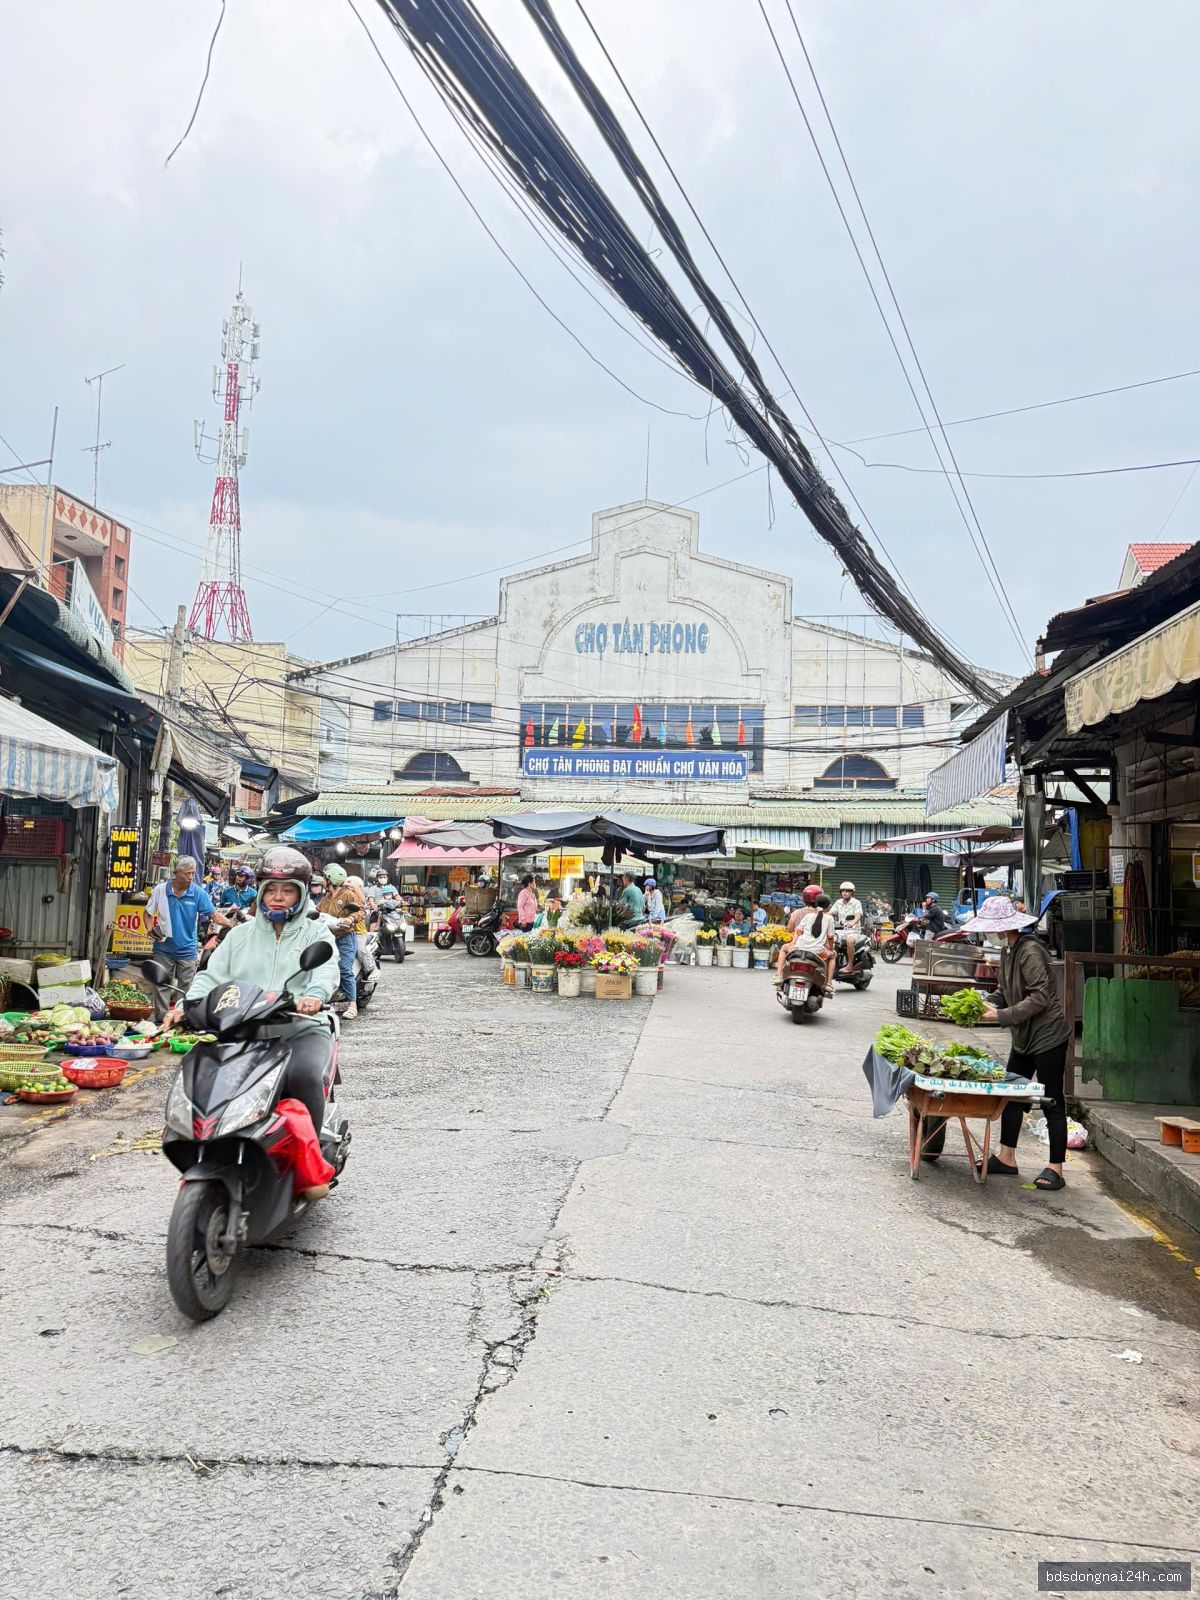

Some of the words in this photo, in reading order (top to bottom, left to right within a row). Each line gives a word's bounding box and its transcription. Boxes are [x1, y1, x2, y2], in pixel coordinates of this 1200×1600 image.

[649, 622, 709, 654] PHONG
[528, 757, 550, 775] CHỢ
[553, 756, 573, 772] TÂN
[576, 758, 610, 773] PHONG
[613, 759, 633, 776] ĐẠT
[635, 755, 671, 774] CHUẨN
[673, 759, 695, 777] CHỢ
[698, 758, 720, 775] VĂN
[722, 758, 743, 776] HÓA
[118, 844, 131, 857] MÌ
[113, 860, 132, 875] ĐẶC
[110, 875, 134, 891] RUỘT
